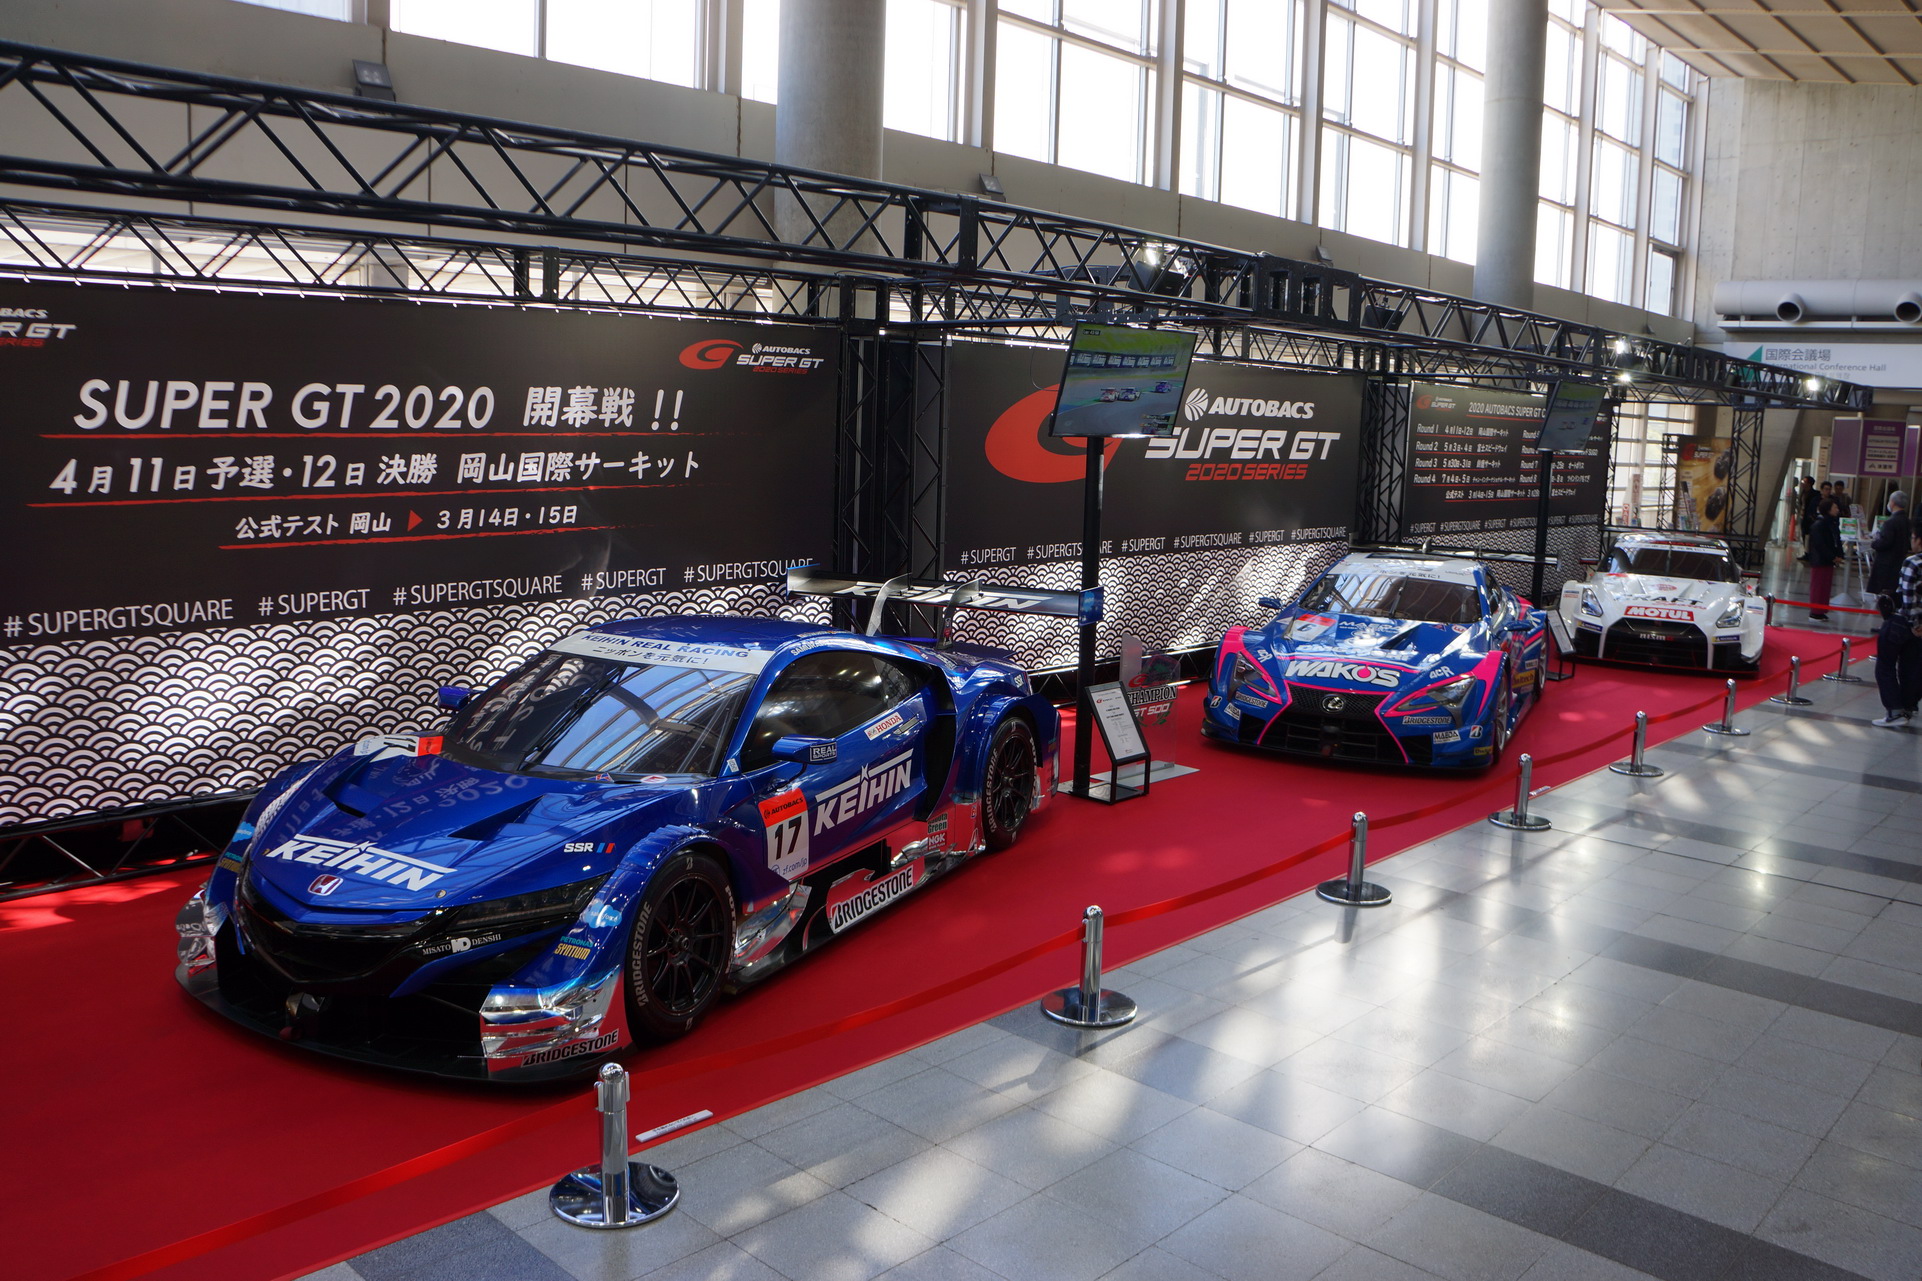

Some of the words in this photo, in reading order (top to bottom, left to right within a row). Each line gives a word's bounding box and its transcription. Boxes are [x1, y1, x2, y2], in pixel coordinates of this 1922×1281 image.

[25, 322, 78, 339] GT
[762, 345, 811, 355] AUTOBACS
[1765, 348, 1831, 362] 国際会議場
[736, 354, 797, 368] SUPER
[798, 357, 825, 369] GT
[1819, 362, 1867, 371] Conference
[1869, 363, 1887, 372] Hall
[73, 377, 274, 430] SUPER
[523, 385, 636, 428] 開幕戦
[1208, 396, 1315, 419] AUTOBACS
[1468, 402, 1485, 413] 2020
[1485, 403, 1515, 416] AUTOBACS
[1515, 407, 1533, 417] SUPER
[1533, 408, 1541, 418] GT
[1417, 423, 1435, 434] Round
[1144, 426, 1288, 460] SUPER
[1289, 430, 1341, 460] GT
[1415, 440, 1433, 451] Round
[1433, 441, 1439, 451] 2
[457, 450, 700, 484] 岡山国際サーキット
[1415, 458, 1433, 468] Round
[1433, 458, 1438, 468] 3
[1413, 474, 1431, 483] Round
[1431, 474, 1436, 483] 4
[235, 513, 340, 540] 公式テスト
[349, 512, 392, 534] 岡山
[960, 546, 1017, 565] #SUPERGT
[1121, 536, 1166, 553] #SUPERGT
[1173, 532, 1243, 549] #SUPERGTSQUARE
[1249, 529, 1285, 543] #SUPERGT
[1291, 526, 1347, 541] #SUPERGTSQUARE
[1627, 606, 1691, 620] MOTUL
[581, 633, 631, 647] KEIHIN
[630, 639, 671, 651] REAL
[676, 644, 750, 658] RACING
[1147, 703, 1171, 716] 500
[875, 715, 902, 733] HONDA
[1403, 715, 1451, 725] BRIDGESTONE
[813, 744, 837, 755] REAL
[813, 759, 912, 837] KEIHIN
[774, 815, 803, 861] 17
[928, 832, 946, 846] NGK
[563, 842, 594, 853] SSR
[265, 839, 444, 892] KEIHIN
[833, 867, 913, 930] BRIDGESTONE
[422, 943, 451, 956] MISATO
[472, 933, 502, 946] DENSHI
[560, 936, 594, 948] PETRONAS
[553, 943, 591, 960] SYNTIUM
[633, 901, 652, 1007] BRIDGESTONE
[522, 1029, 619, 1067] BRIDGESTONE
